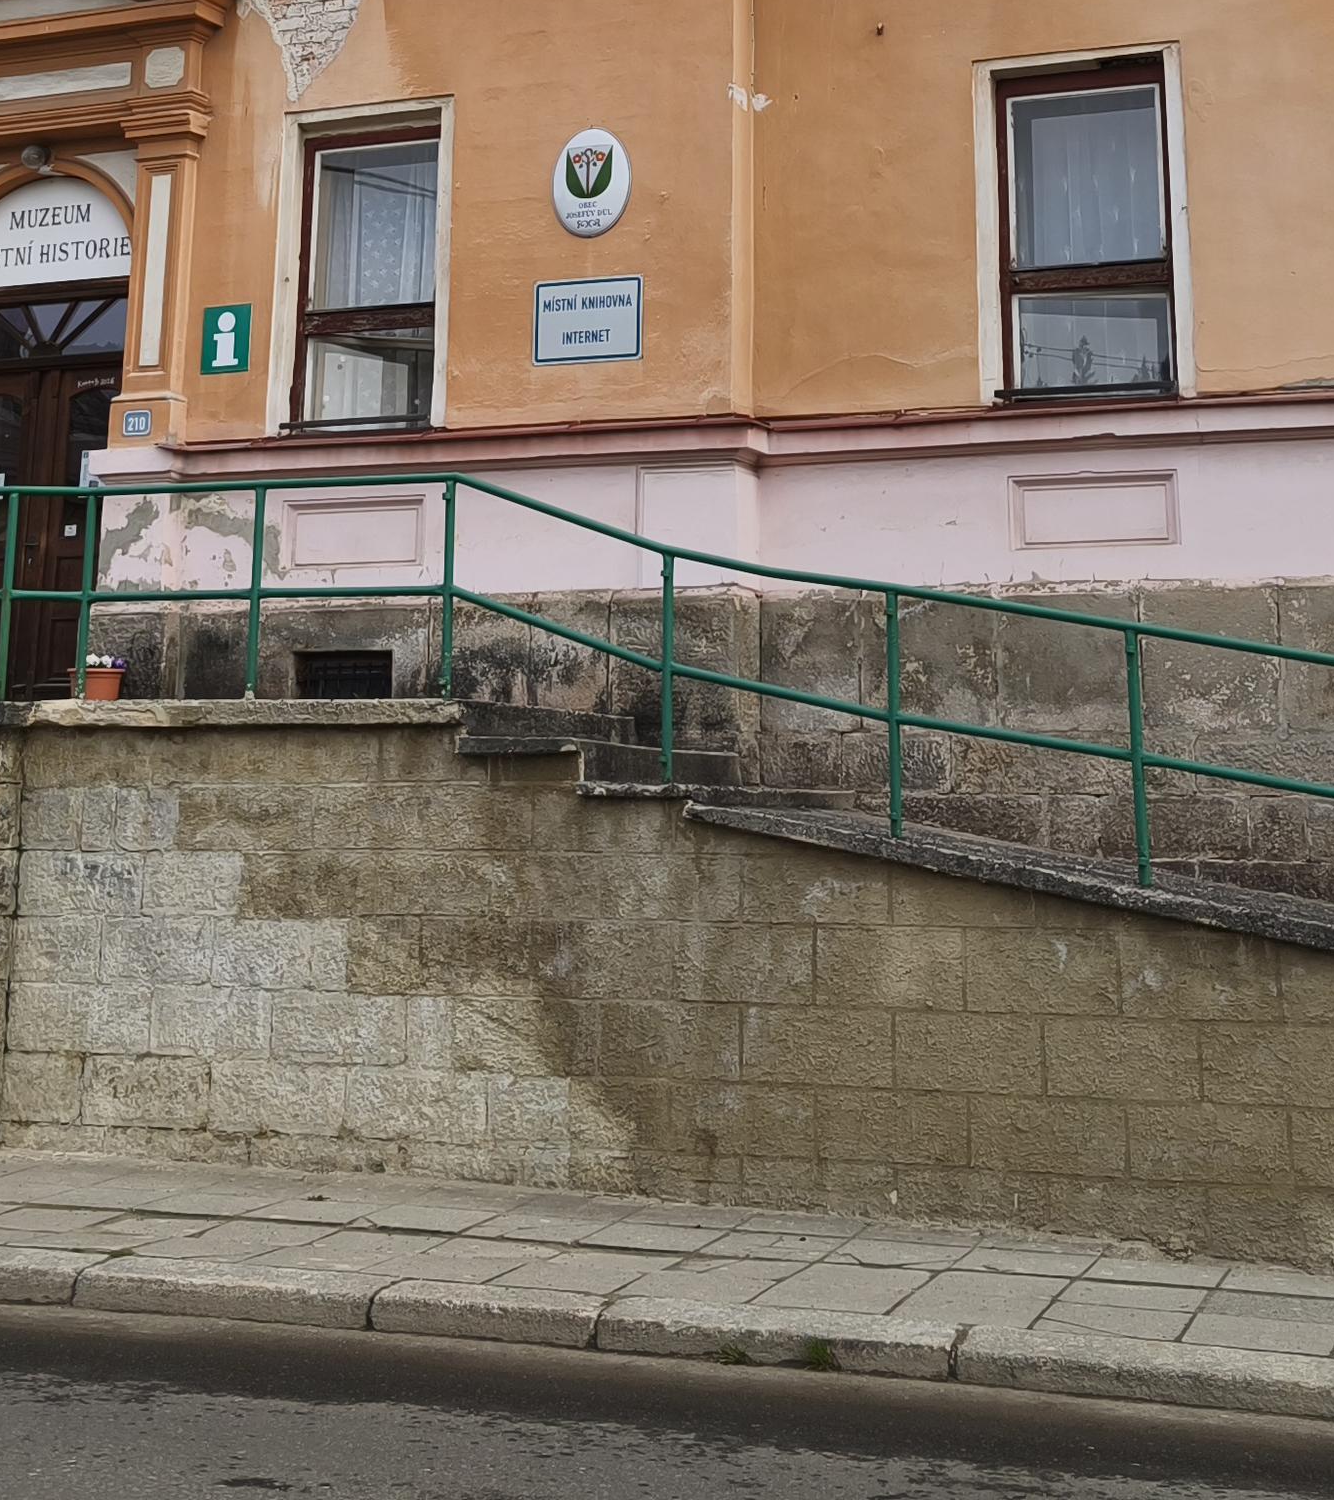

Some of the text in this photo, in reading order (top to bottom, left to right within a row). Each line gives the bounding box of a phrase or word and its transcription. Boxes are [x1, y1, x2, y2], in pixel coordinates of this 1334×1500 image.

[9, 203, 92, 231] MUZEUM
[39, 236, 131, 264] HISTORIE
[543, 293, 633, 313] MÍSTNÍ KNIHOVNA
[562, 328, 611, 346] INTERNET
[127, 416, 146, 431] 210
